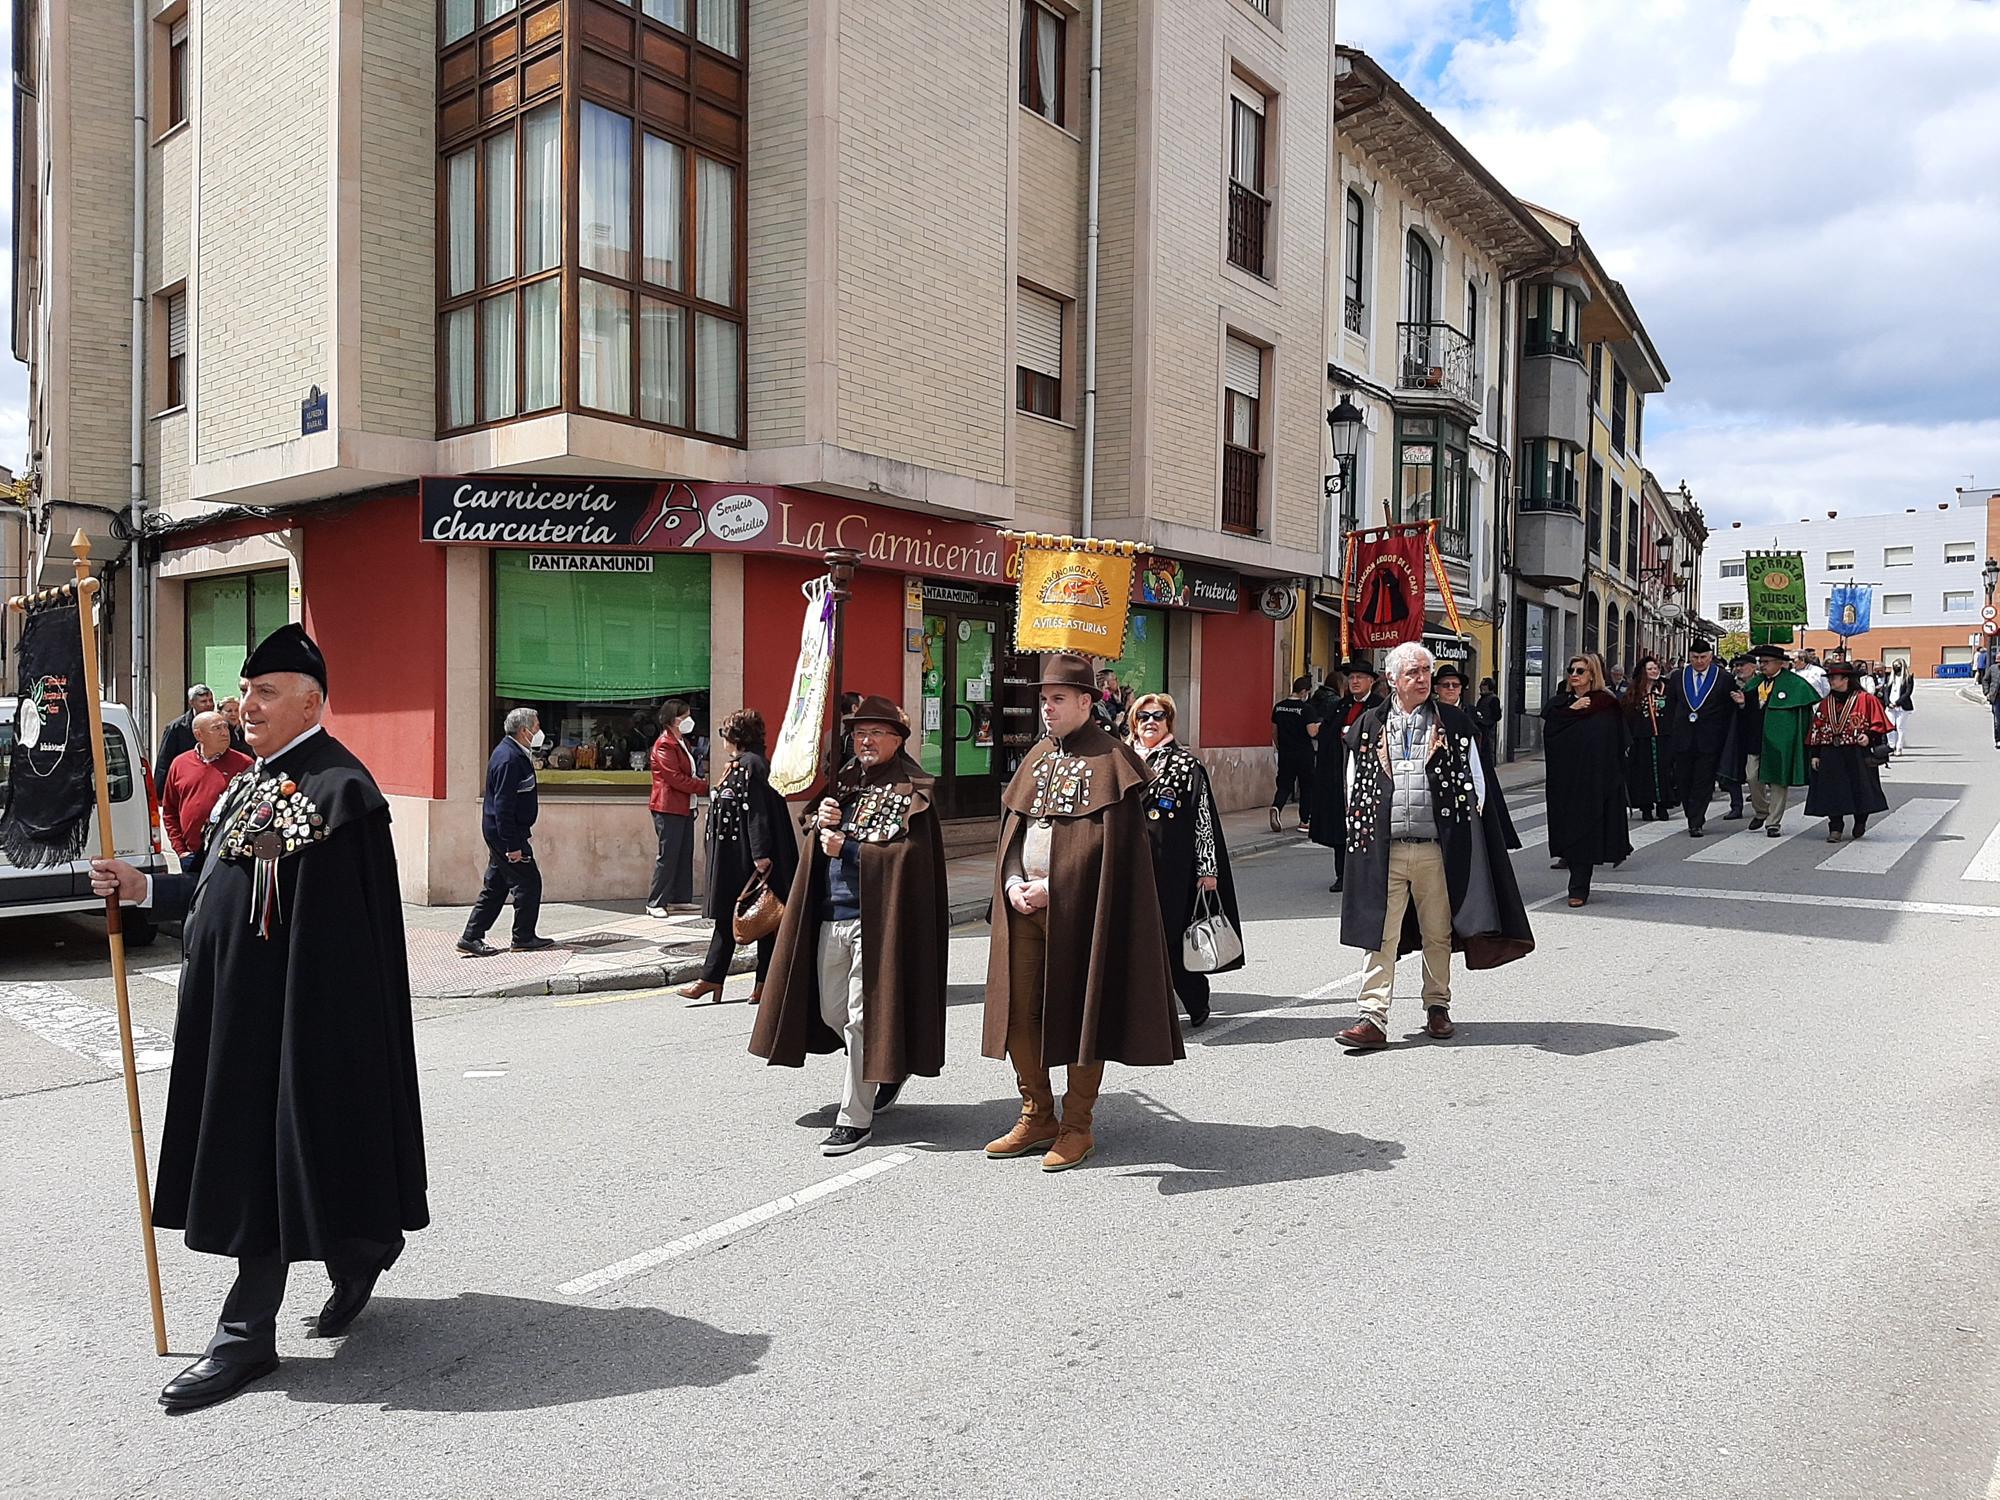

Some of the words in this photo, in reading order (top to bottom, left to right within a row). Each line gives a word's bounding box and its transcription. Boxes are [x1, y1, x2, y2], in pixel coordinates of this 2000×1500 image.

[453, 483, 616, 512] Carnicería
[716, 498, 753, 517] Servicio
[432, 511, 616, 544] Charcutería
[720, 517, 765, 538] Domicilio
[735, 514, 743, 522] a
[777, 502, 831, 551] La
[835, 514, 998, 577] Carnicería
[532, 556, 650, 571] PANTARAMUNDI
[1085, 569, 1099, 582] DEL
[1397, 557, 1406, 567] DE
[1408, 575, 1418, 595] CAPA
[922, 586, 977, 604] ANTARAMUNDI
[1194, 579, 1238, 603] Frutería
[1759, 593, 1796, 604] QUESU
